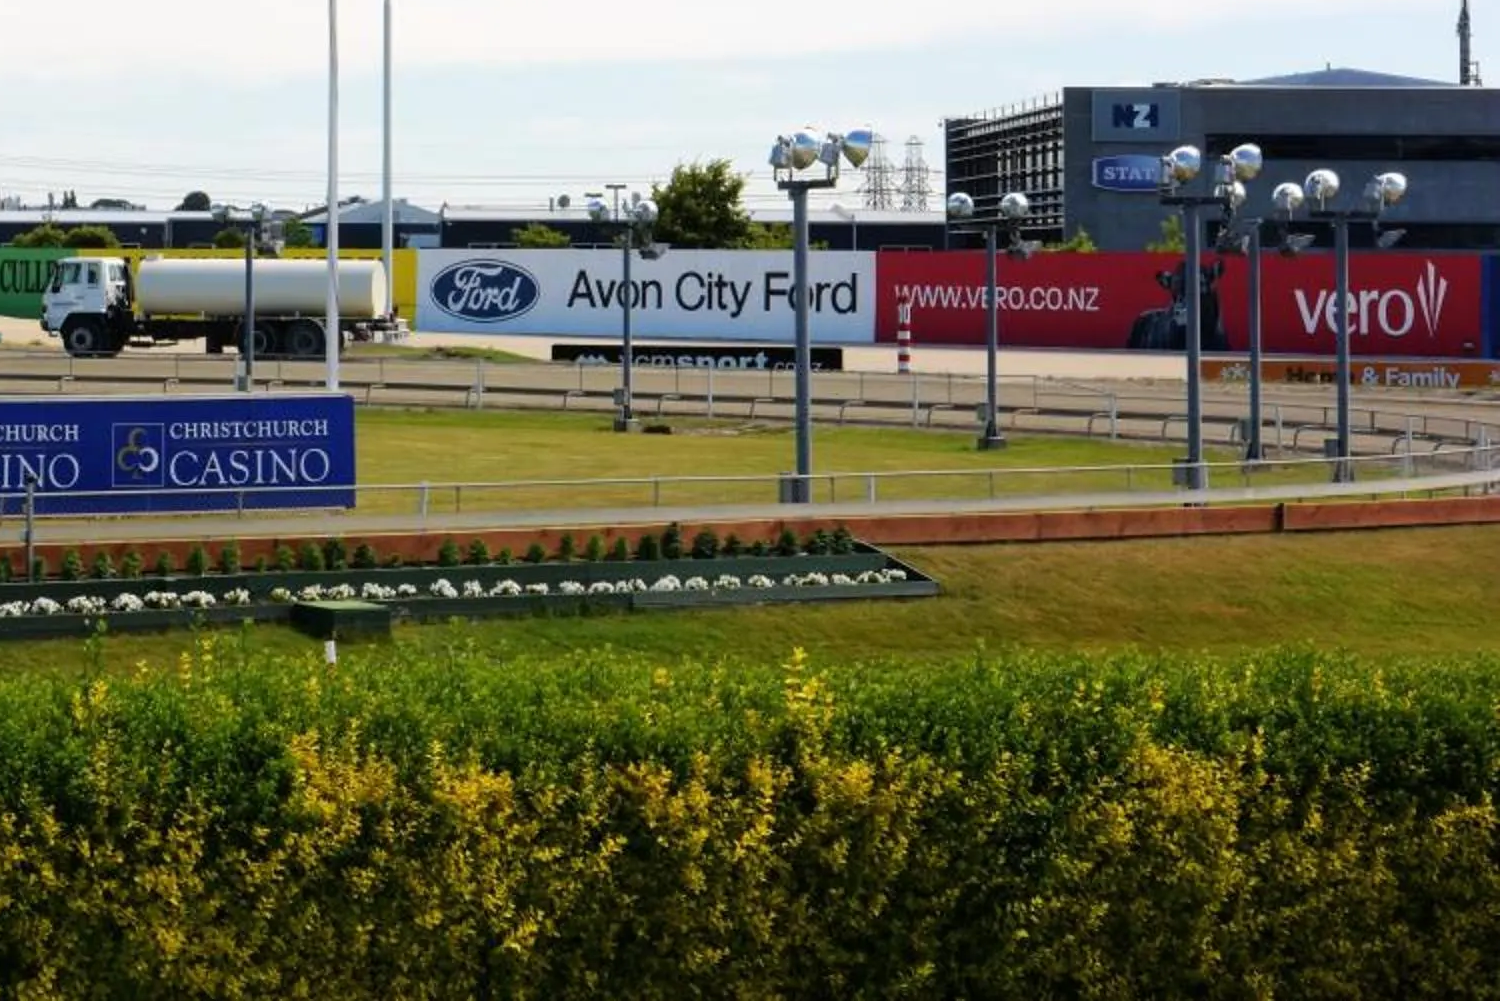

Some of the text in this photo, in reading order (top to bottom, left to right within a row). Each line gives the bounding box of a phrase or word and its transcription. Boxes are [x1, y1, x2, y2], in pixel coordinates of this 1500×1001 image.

[1112, 103, 1159, 128] NZI
[1103, 165, 1157, 181] STAT
[447, 266, 522, 312] Ford
[566, 269, 663, 310] Avon
[675, 270, 753, 319] City
[1293, 288, 1415, 337] vero
[1362, 366, 1380, 385] &
[1386, 367, 1461, 389] Family
[169, 420, 329, 440] CHRISTCHURCH
[169, 448, 331, 486] CASINO
